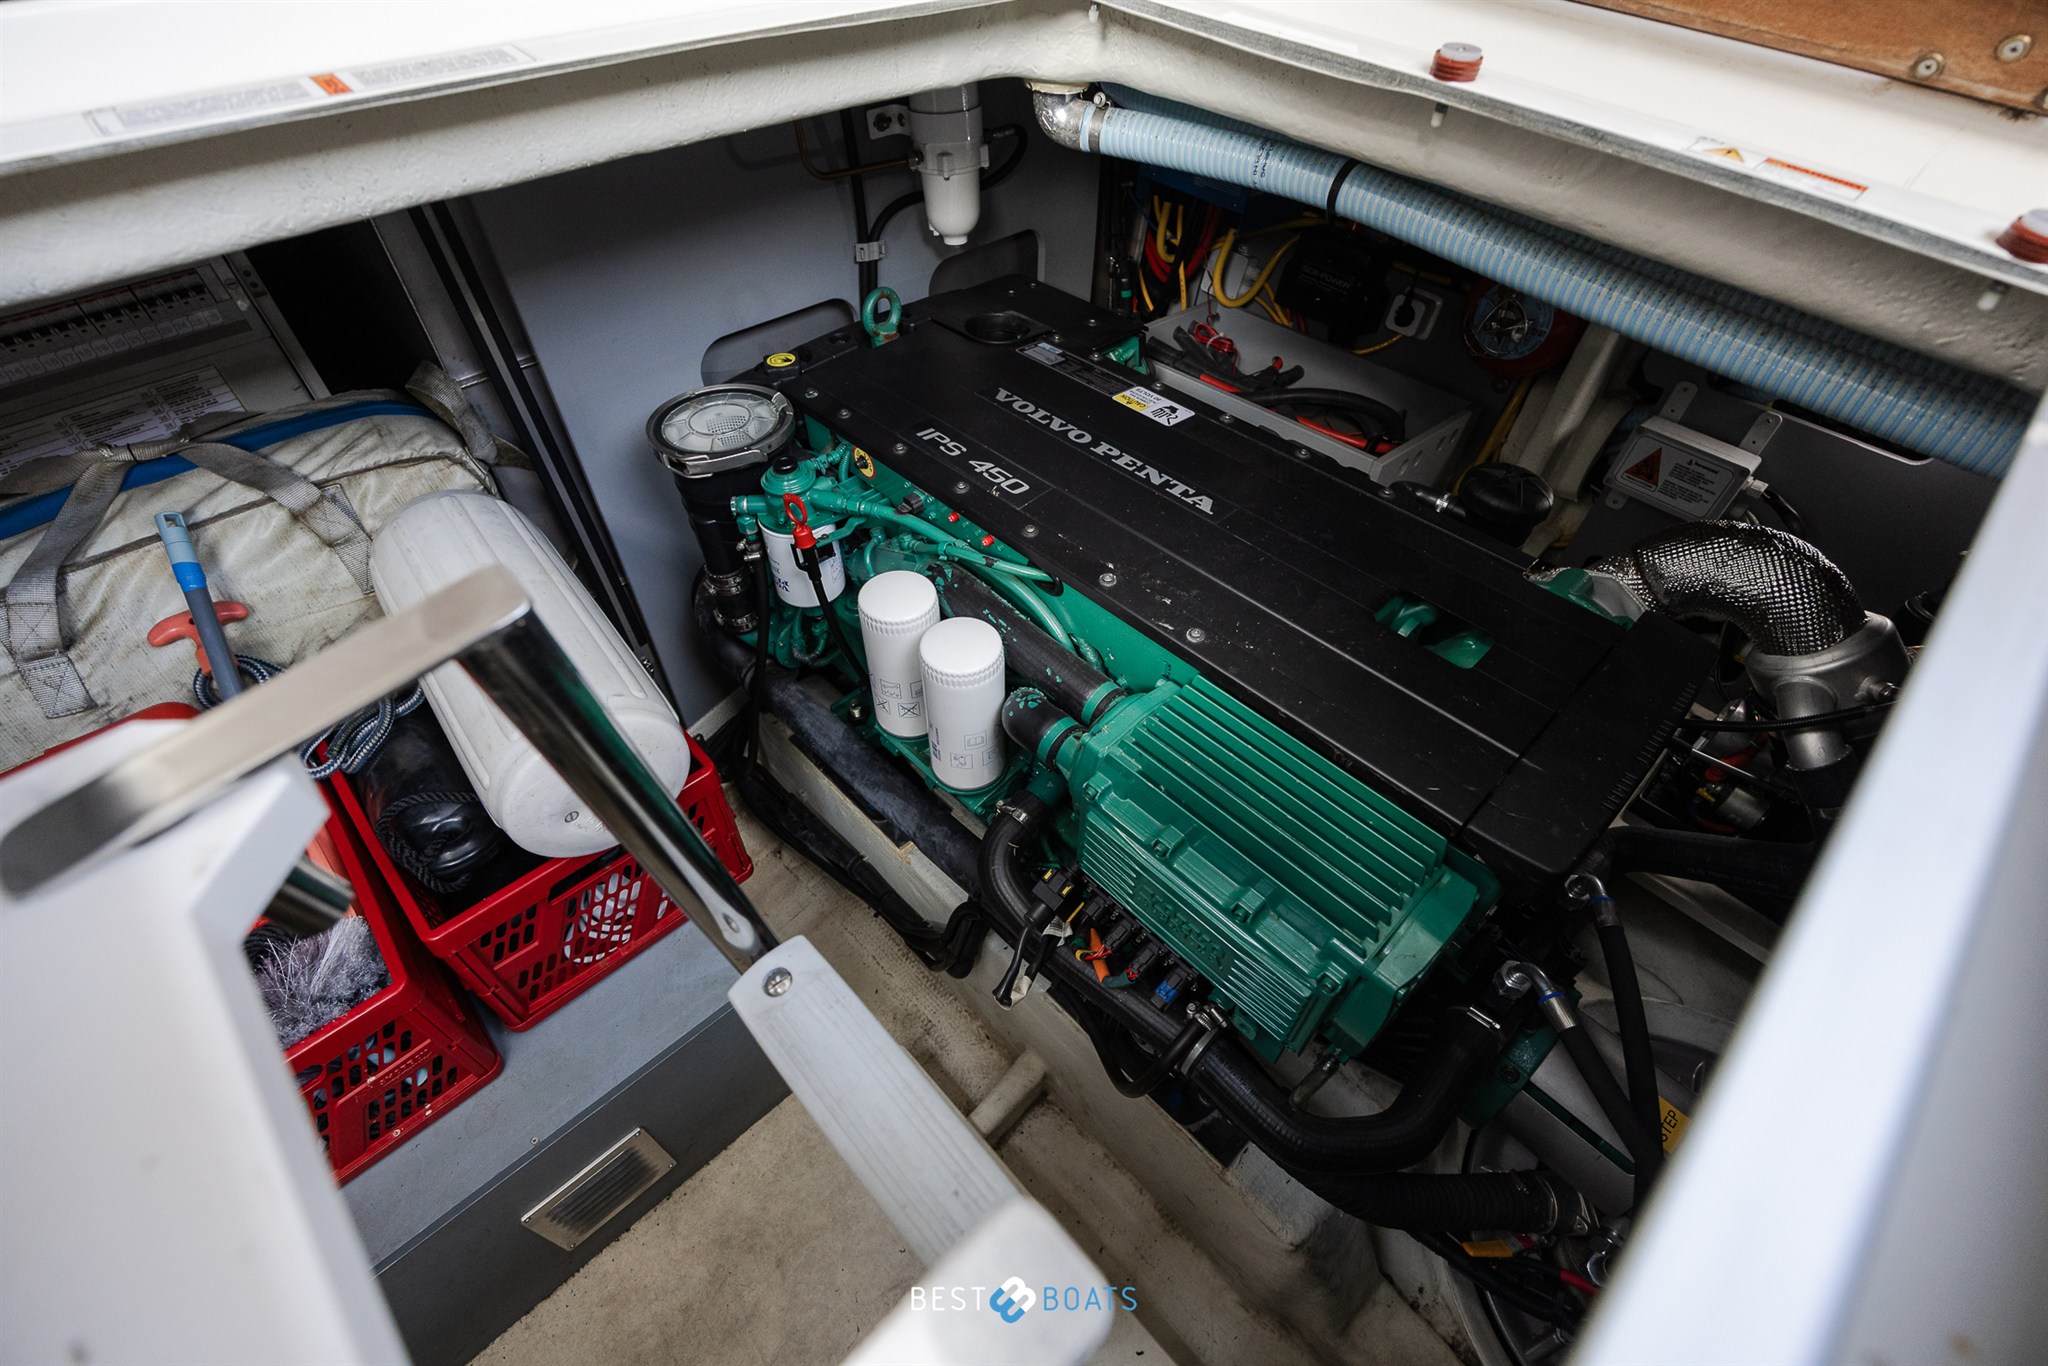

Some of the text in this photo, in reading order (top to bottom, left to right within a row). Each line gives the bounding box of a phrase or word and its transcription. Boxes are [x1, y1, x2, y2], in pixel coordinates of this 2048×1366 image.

[1119, 394, 1147, 408] CAUTION
[915, 427, 1030, 495] IPS 450
[995, 387, 1214, 515] VOLVO PENTA
